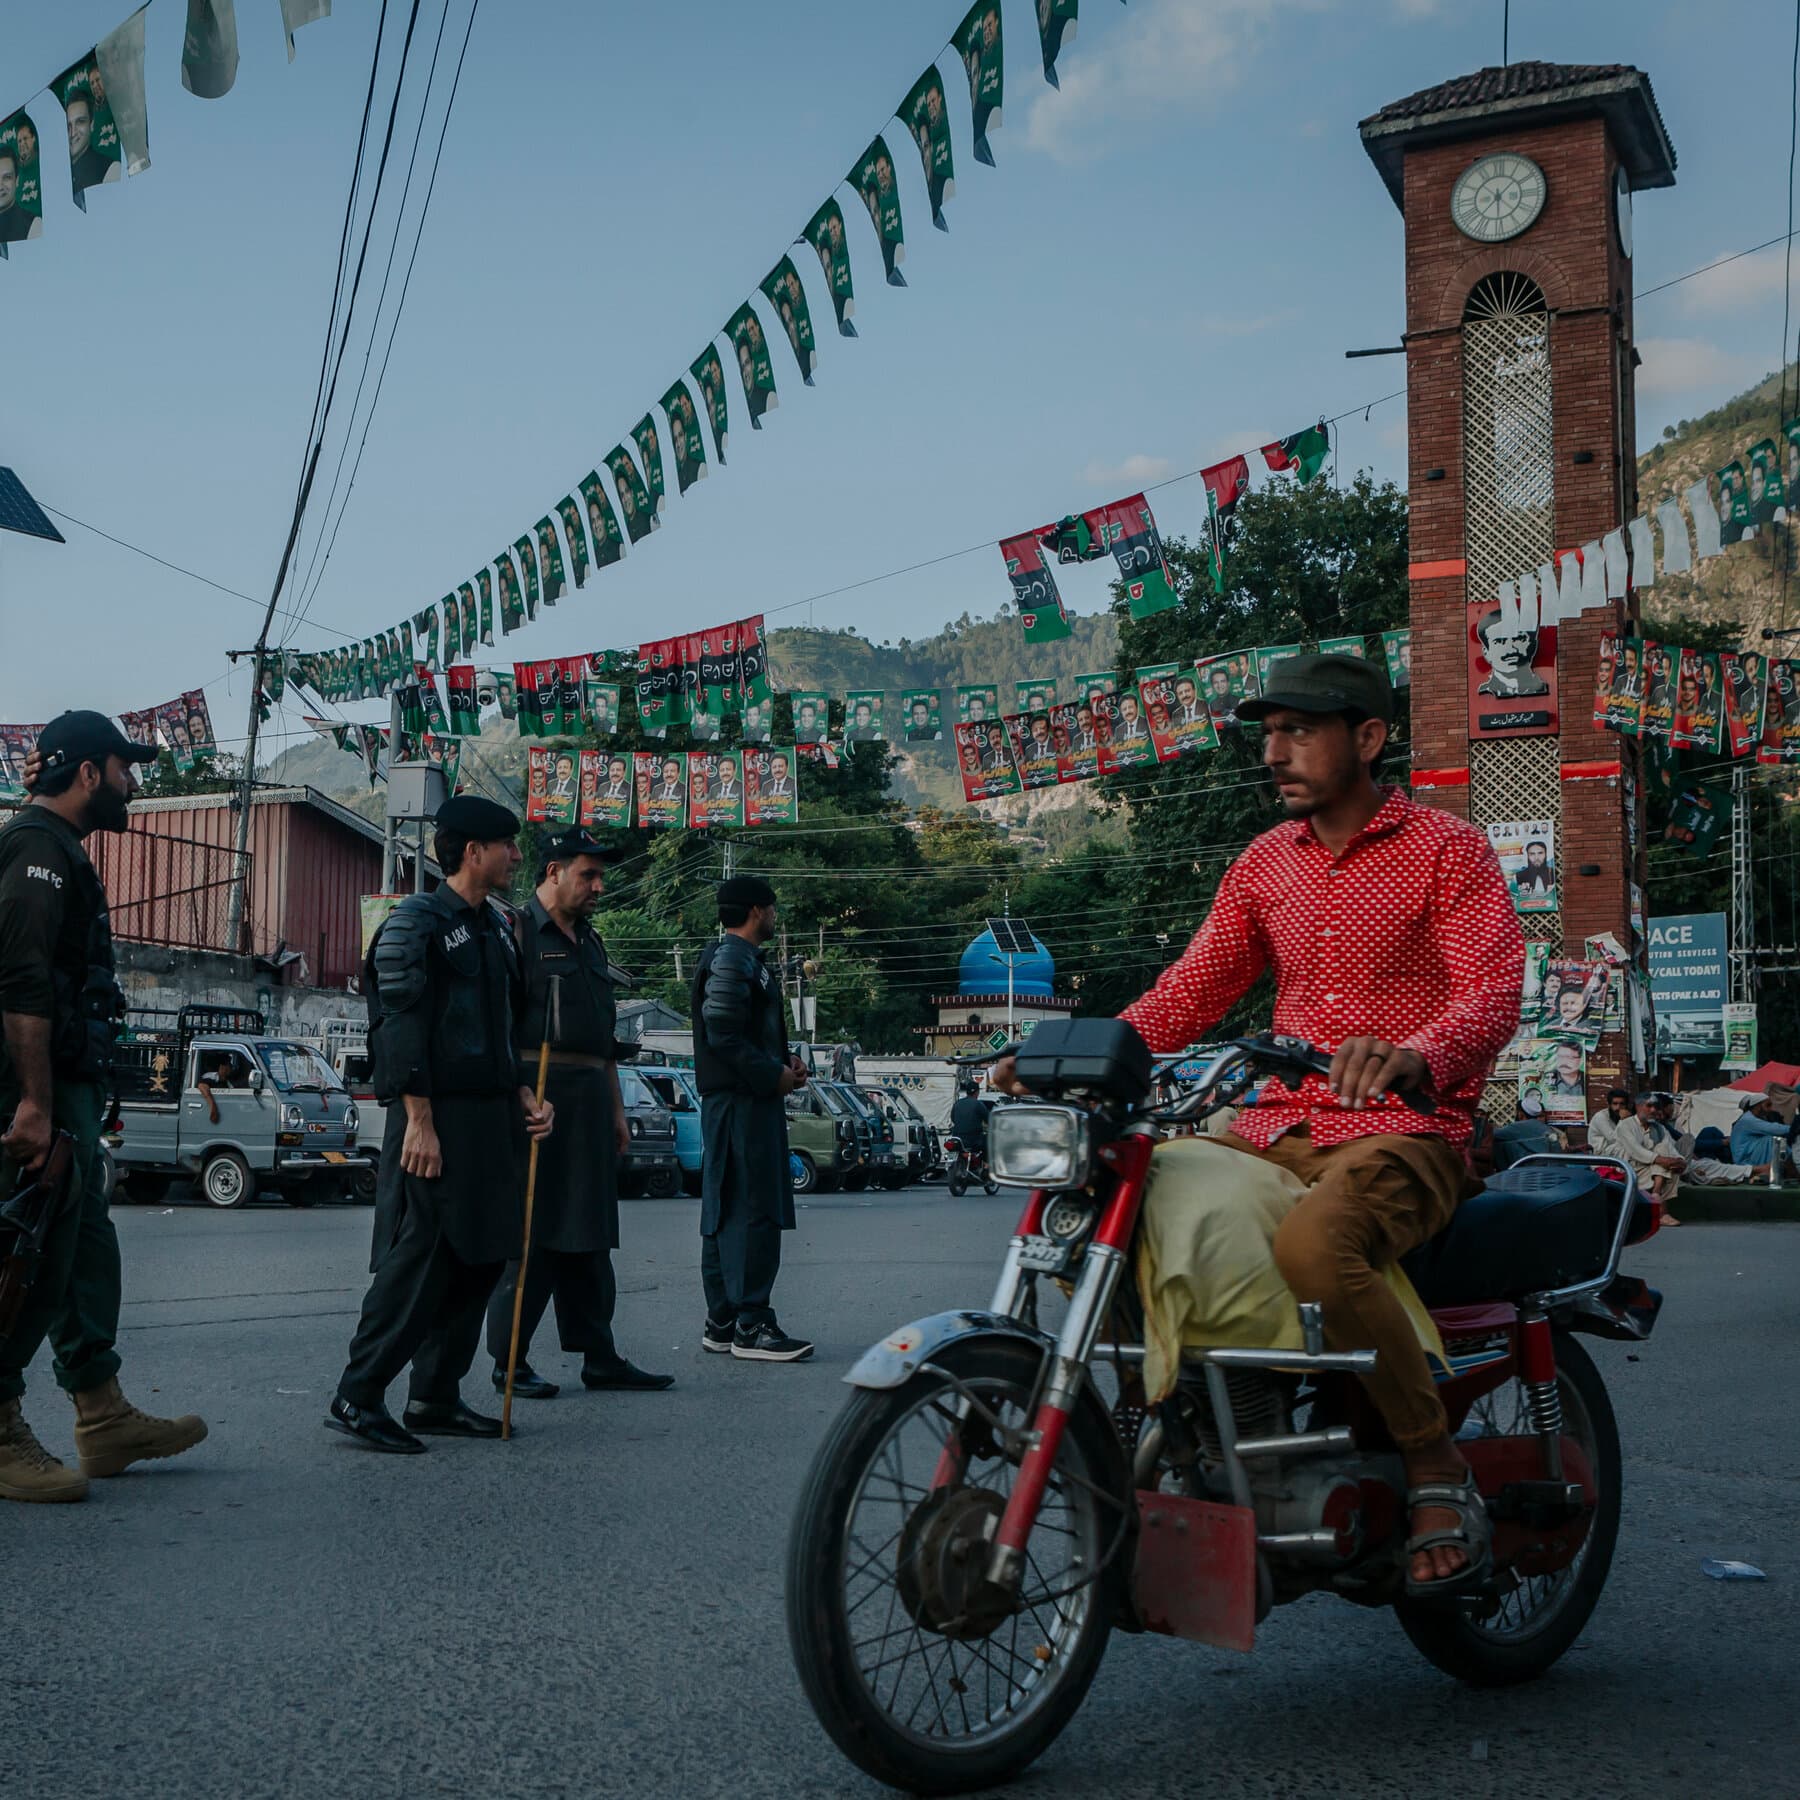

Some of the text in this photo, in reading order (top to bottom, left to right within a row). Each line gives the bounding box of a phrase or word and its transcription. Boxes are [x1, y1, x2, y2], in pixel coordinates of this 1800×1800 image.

[27, 865, 63, 889] PAK FC
[444, 925, 471, 952] AJ&K
[1677, 948, 1717, 957] SERVICES
[1684, 965, 1720, 976] TODAY!
